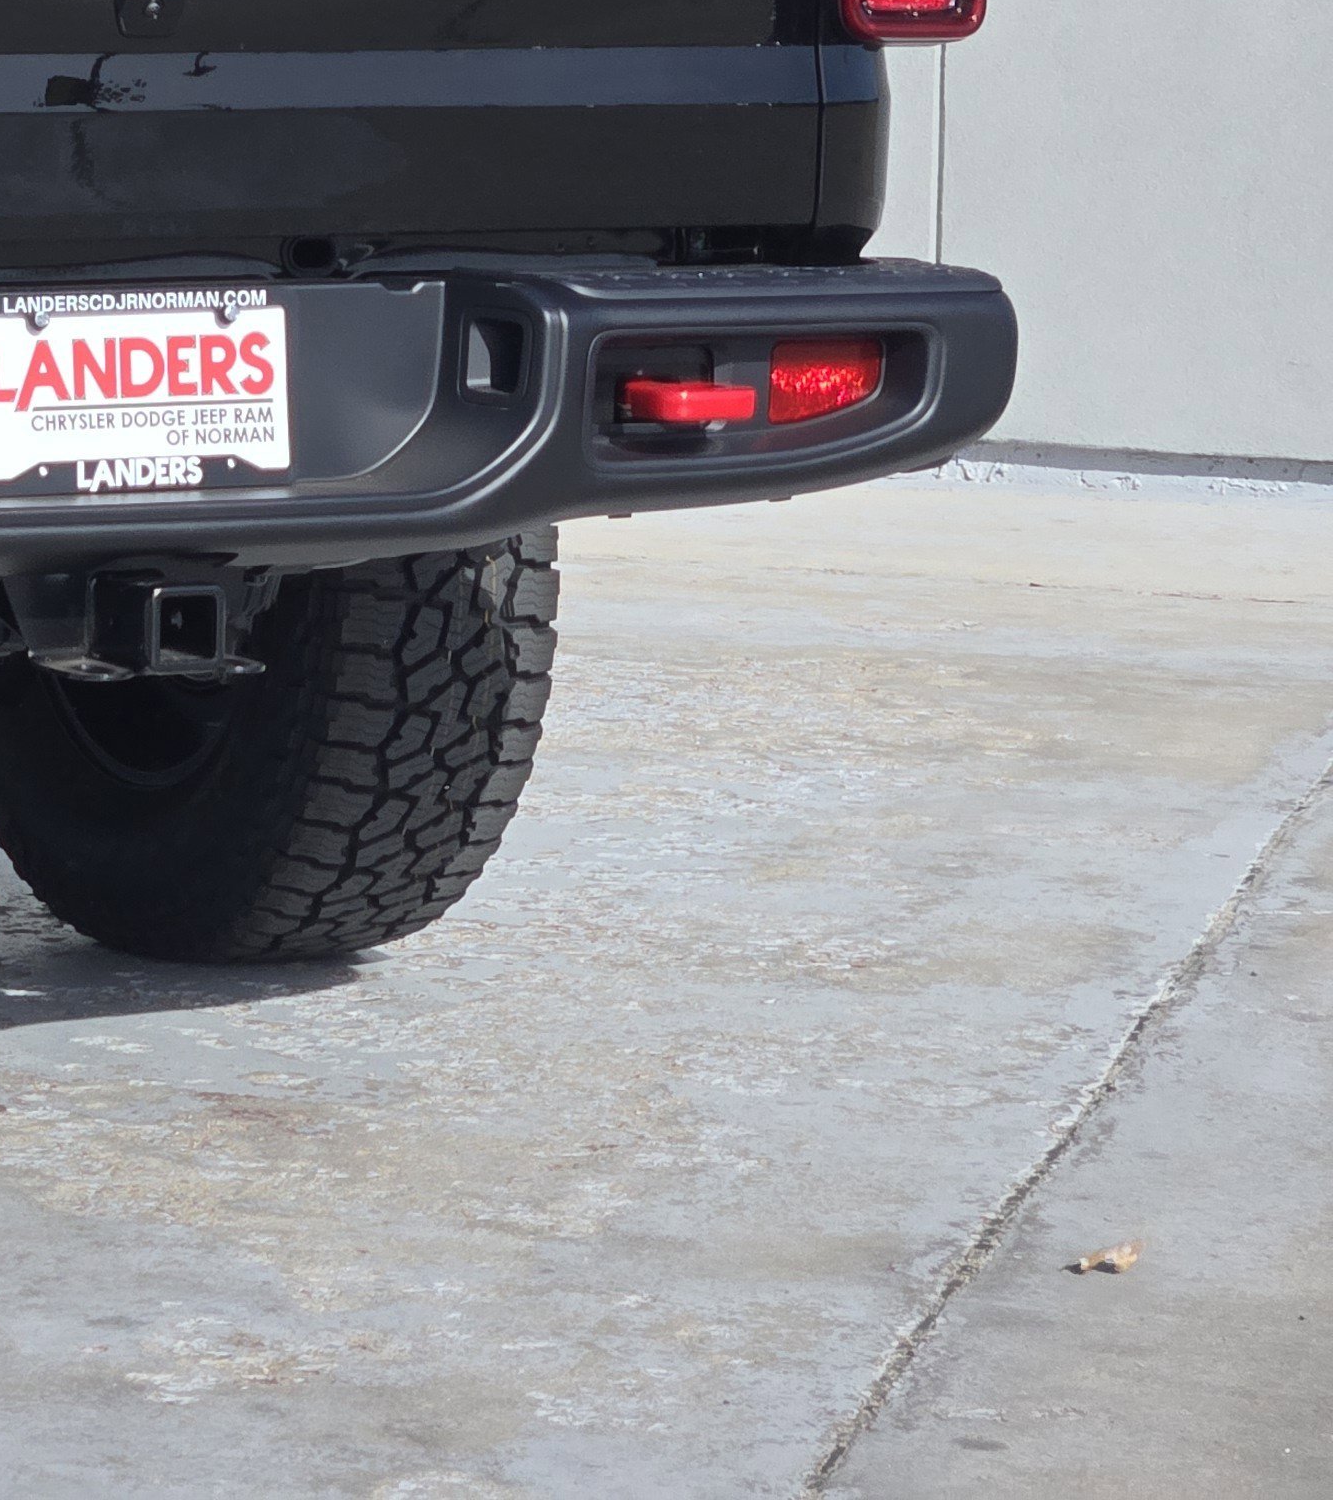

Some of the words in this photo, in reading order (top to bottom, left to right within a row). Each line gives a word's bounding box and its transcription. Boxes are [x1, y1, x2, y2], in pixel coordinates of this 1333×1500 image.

[3, 289, 267, 314] LANDERSCDJRNORMAN.COM
[31, 412, 115, 431] CHRYSLER
[121, 409, 185, 428] DODGE
[191, 408, 227, 425] JEEP
[234, 406, 274, 424] RAM
[166, 428, 190, 445] OF
[195, 426, 275, 444] NORMAN
[76, 455, 203, 492] LANDERS
